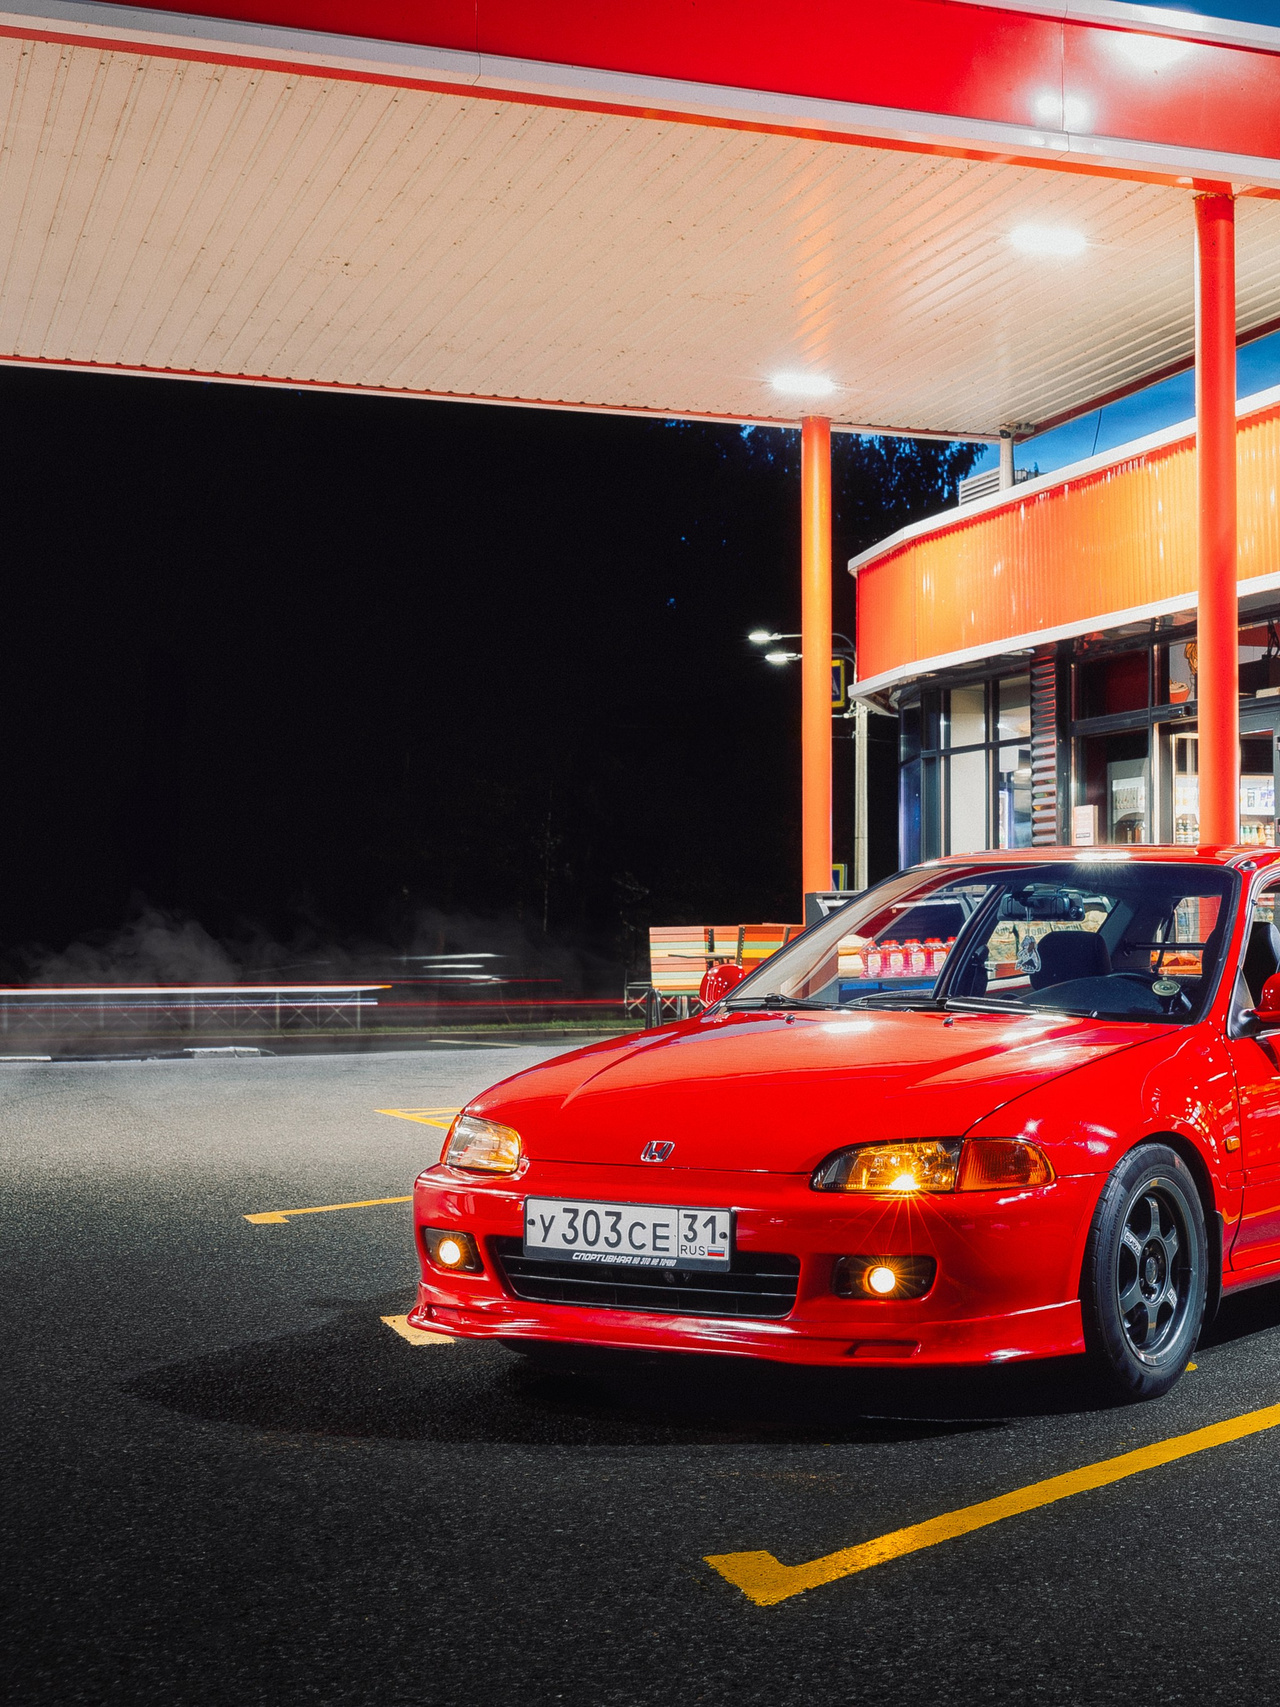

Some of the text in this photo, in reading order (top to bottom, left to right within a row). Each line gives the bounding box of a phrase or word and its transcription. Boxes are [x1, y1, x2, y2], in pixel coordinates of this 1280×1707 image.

[683, 1214, 717, 1245] 31
[680, 1244, 706, 1256] RUS
[572, 1252, 632, 1265] СПОРТИВНАЯ
